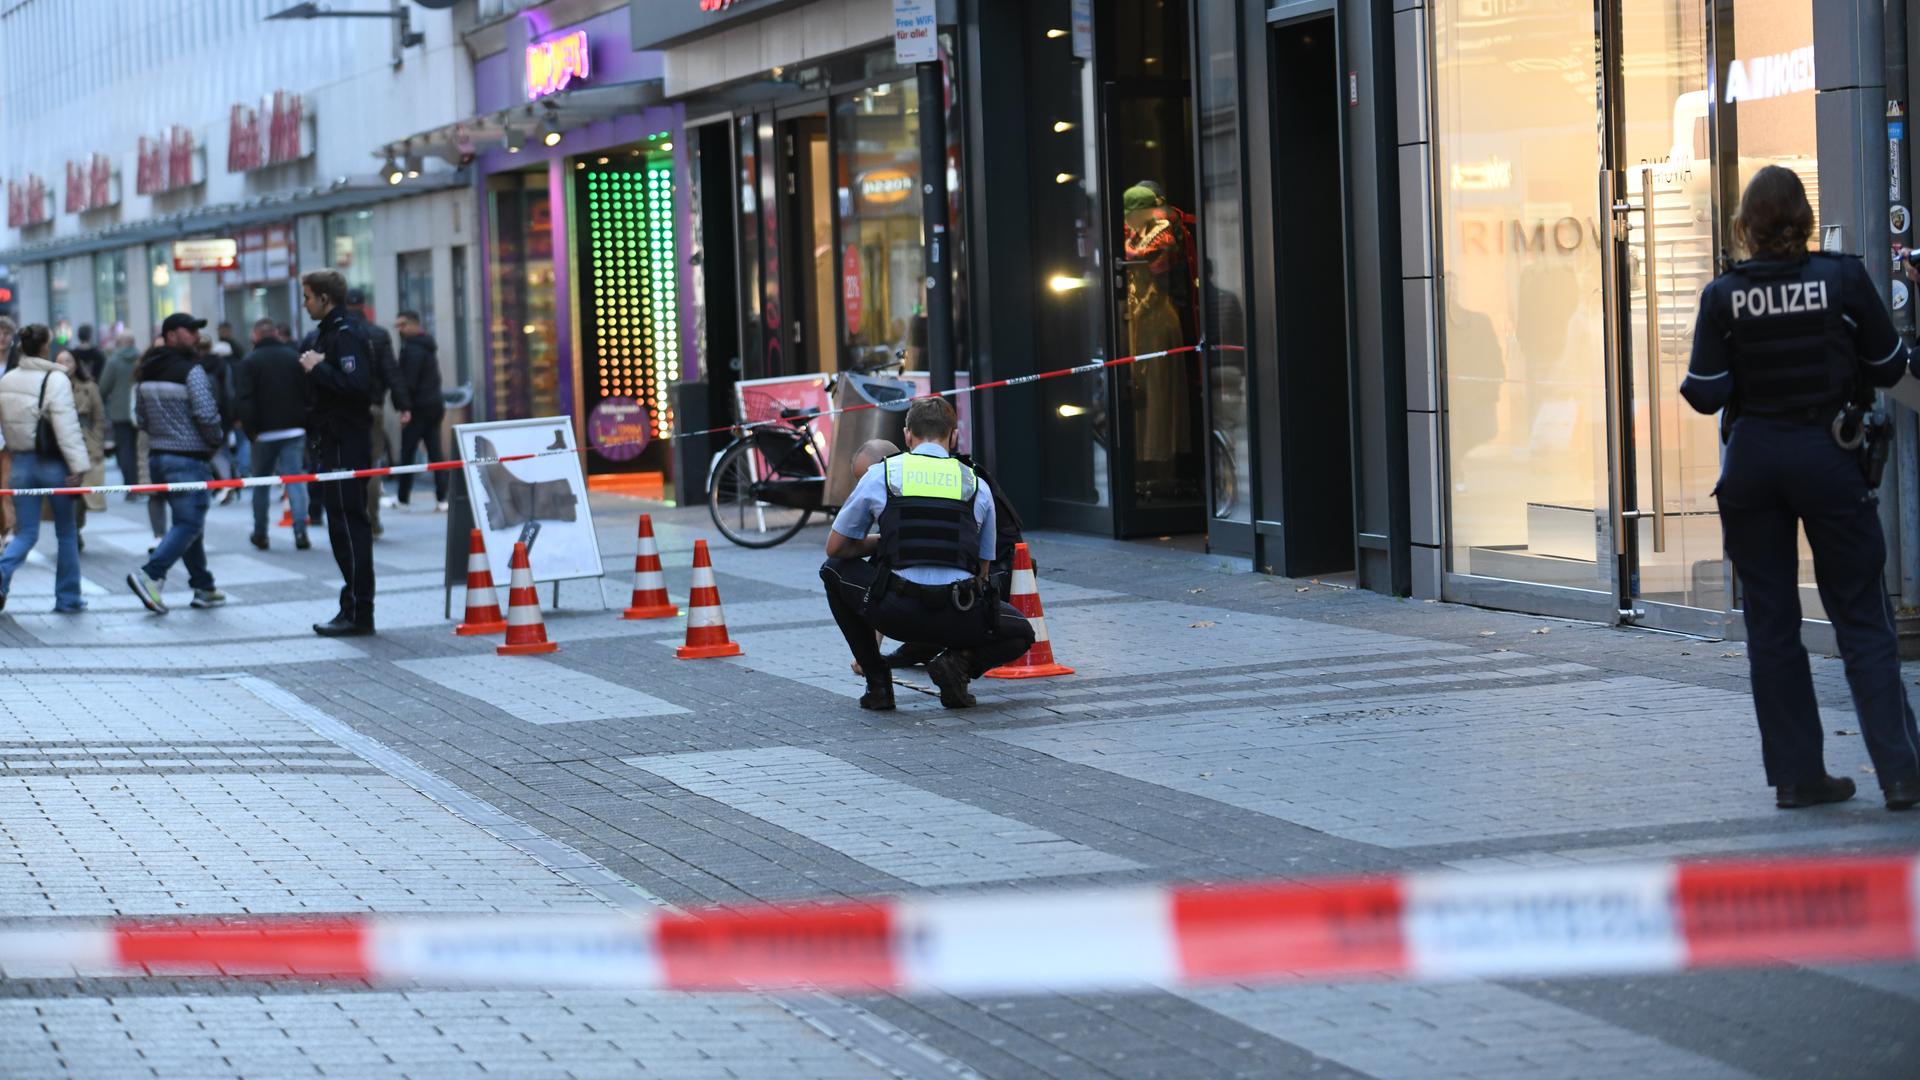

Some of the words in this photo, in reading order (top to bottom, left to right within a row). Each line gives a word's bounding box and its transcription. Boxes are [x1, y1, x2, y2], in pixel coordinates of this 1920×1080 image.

[896, 18, 913, 27] Free
[897, 30, 909, 40] für
[910, 27, 928, 38] alle!
[1731, 280, 1828, 319] POLIZEI
[907, 471, 958, 488] POLIZEI
